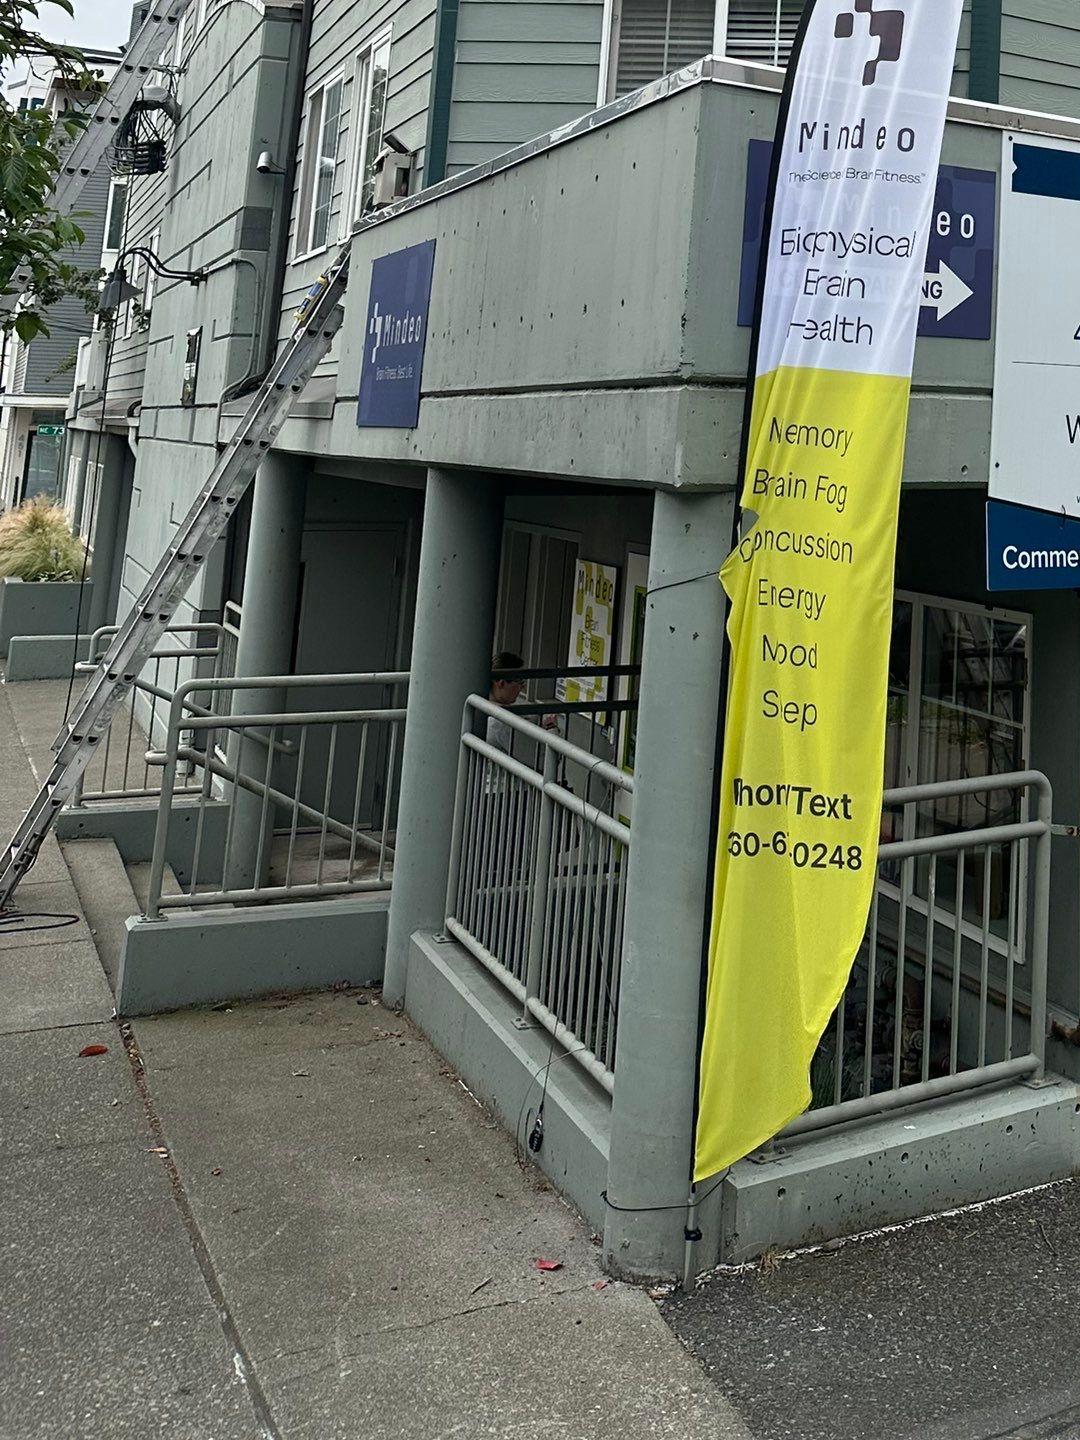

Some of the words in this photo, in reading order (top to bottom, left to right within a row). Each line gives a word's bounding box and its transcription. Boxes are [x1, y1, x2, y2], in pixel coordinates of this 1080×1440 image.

[382, 310, 422, 347] Mindeo
[752, 468, 807, 499] Brain
[814, 474, 848, 513] Fog
[739, 529, 853, 564] Concussion
[758, 578, 826, 621] Energy
